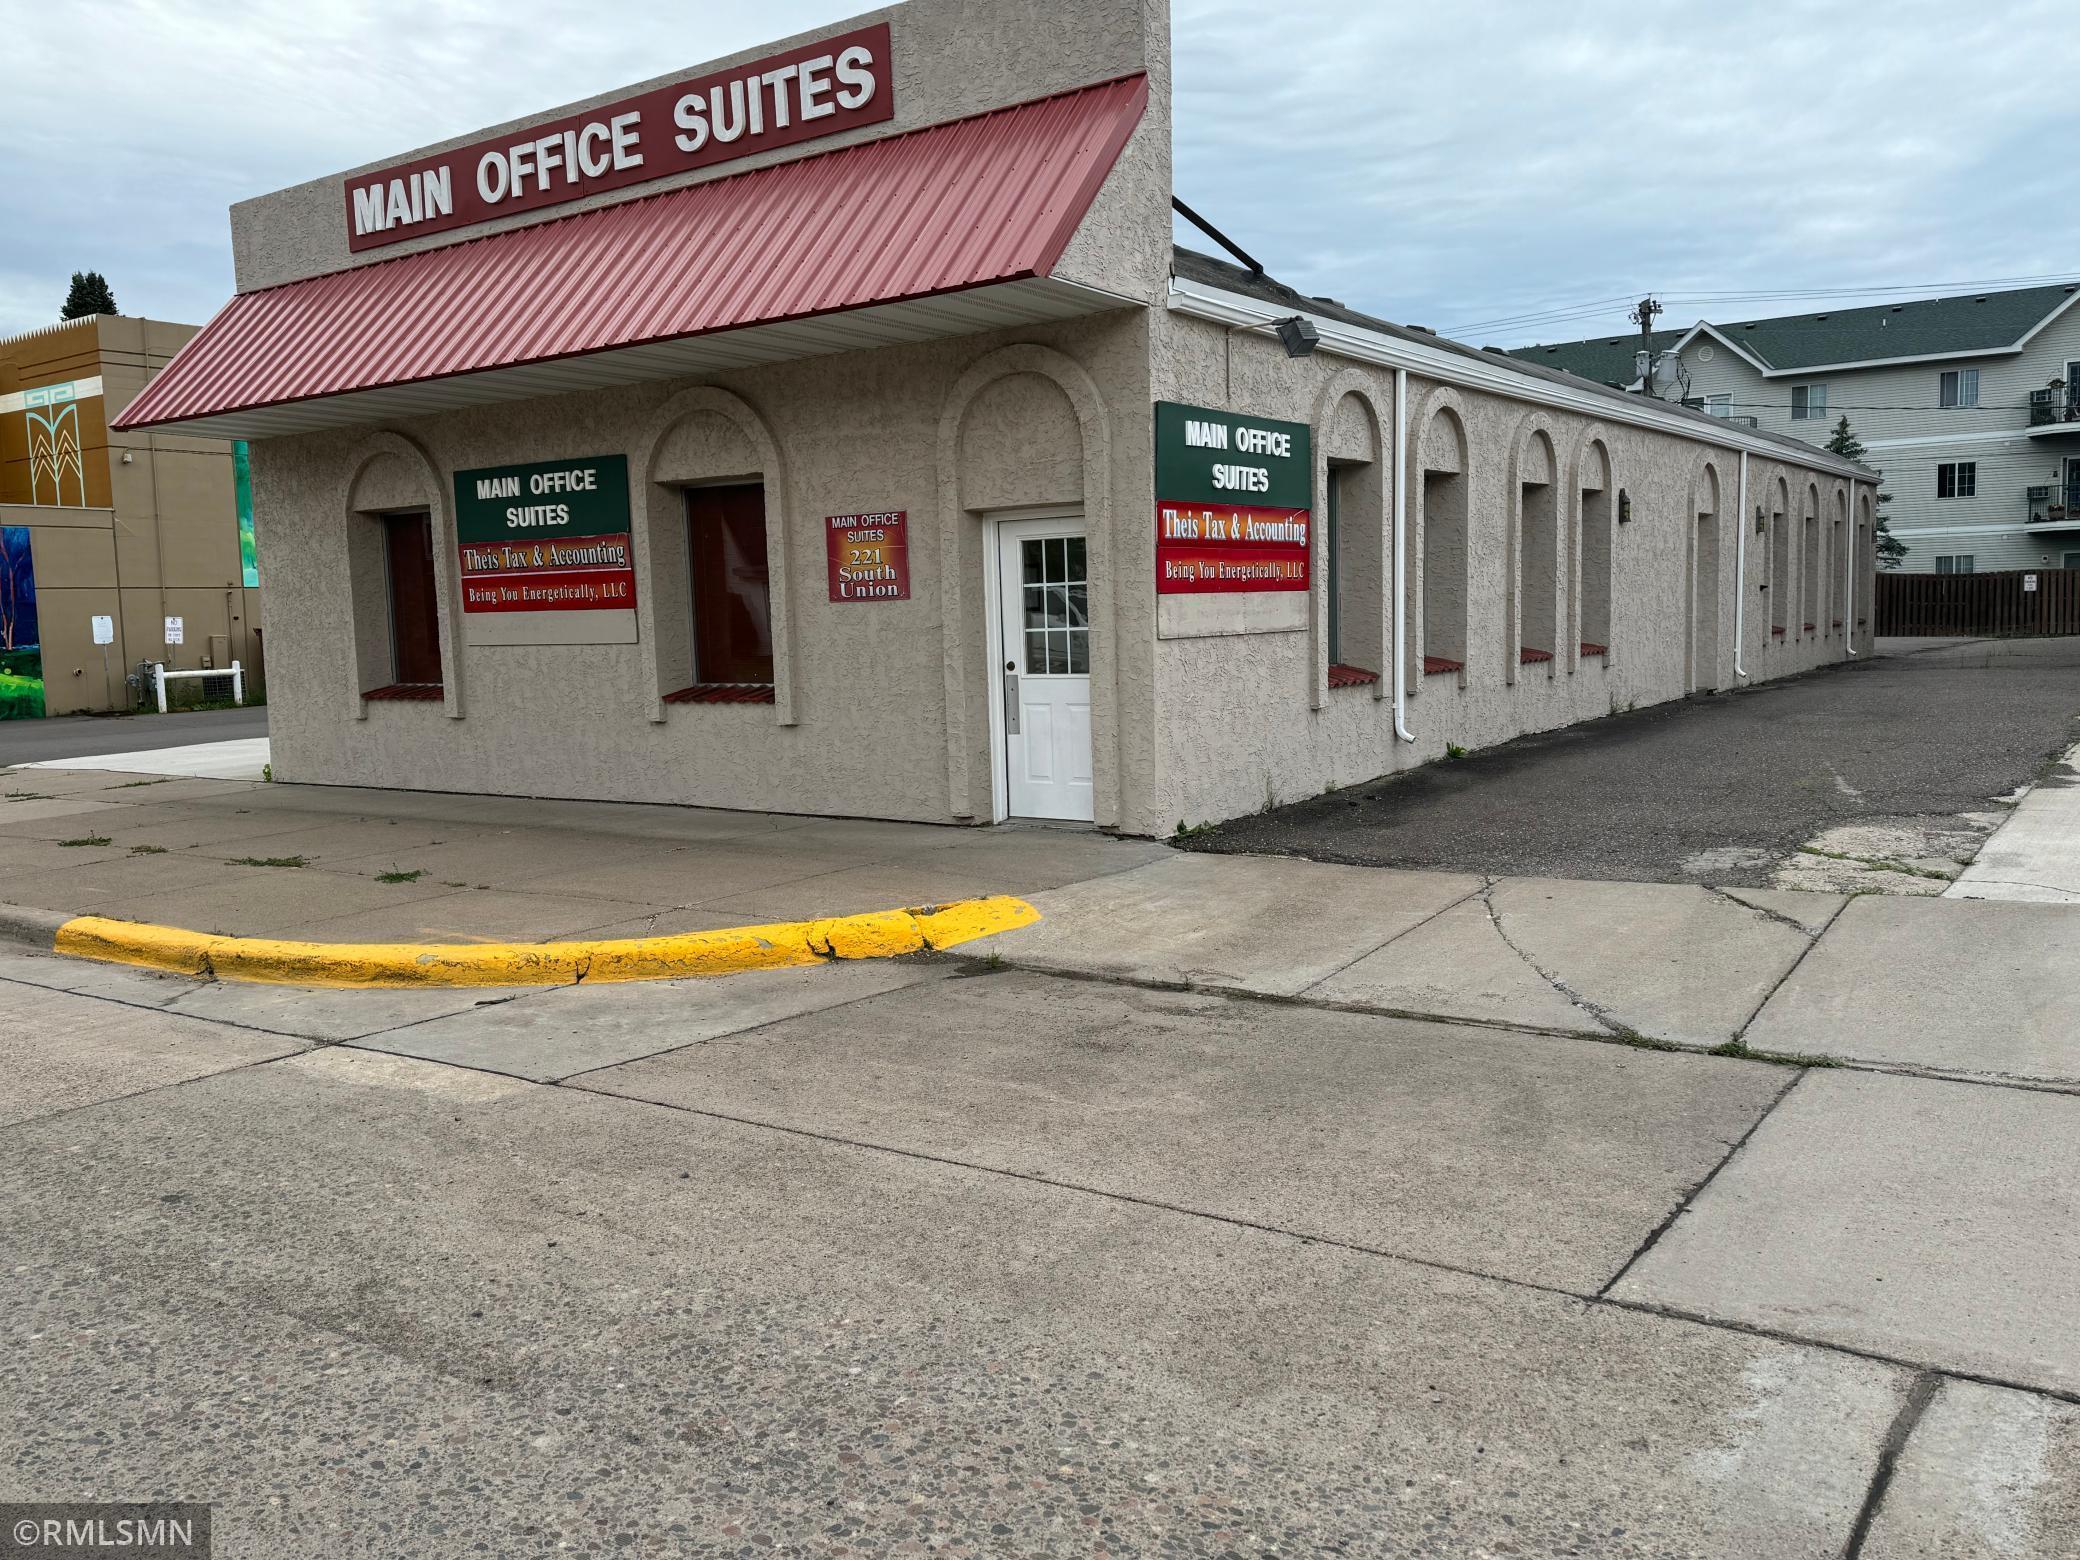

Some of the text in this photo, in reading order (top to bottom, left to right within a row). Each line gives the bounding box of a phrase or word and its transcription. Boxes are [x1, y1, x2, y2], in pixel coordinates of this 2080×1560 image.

[353, 46, 876, 236] MAIN OFFICE SUITES
[1185, 420, 1291, 458] MAIN OFFICE
[477, 469, 597, 500] MAIN OFFICE
[1212, 463, 1269, 493] SUITES
[506, 504, 569, 528] SUITES
[831, 513, 899, 529] MAIN OFFICE
[1163, 508, 1306, 547] Theis Tax & Accounting
[847, 529, 884, 543] SUITES
[464, 541, 626, 571] Theis Tax & Accounting
[849, 548, 883, 566] 221
[839, 564, 897, 583] South
[1165, 560, 1305, 583] Being You Energetically, LLC
[469, 582, 627, 604] Being You Energetically, LLC
[839, 581, 899, 598] Union
